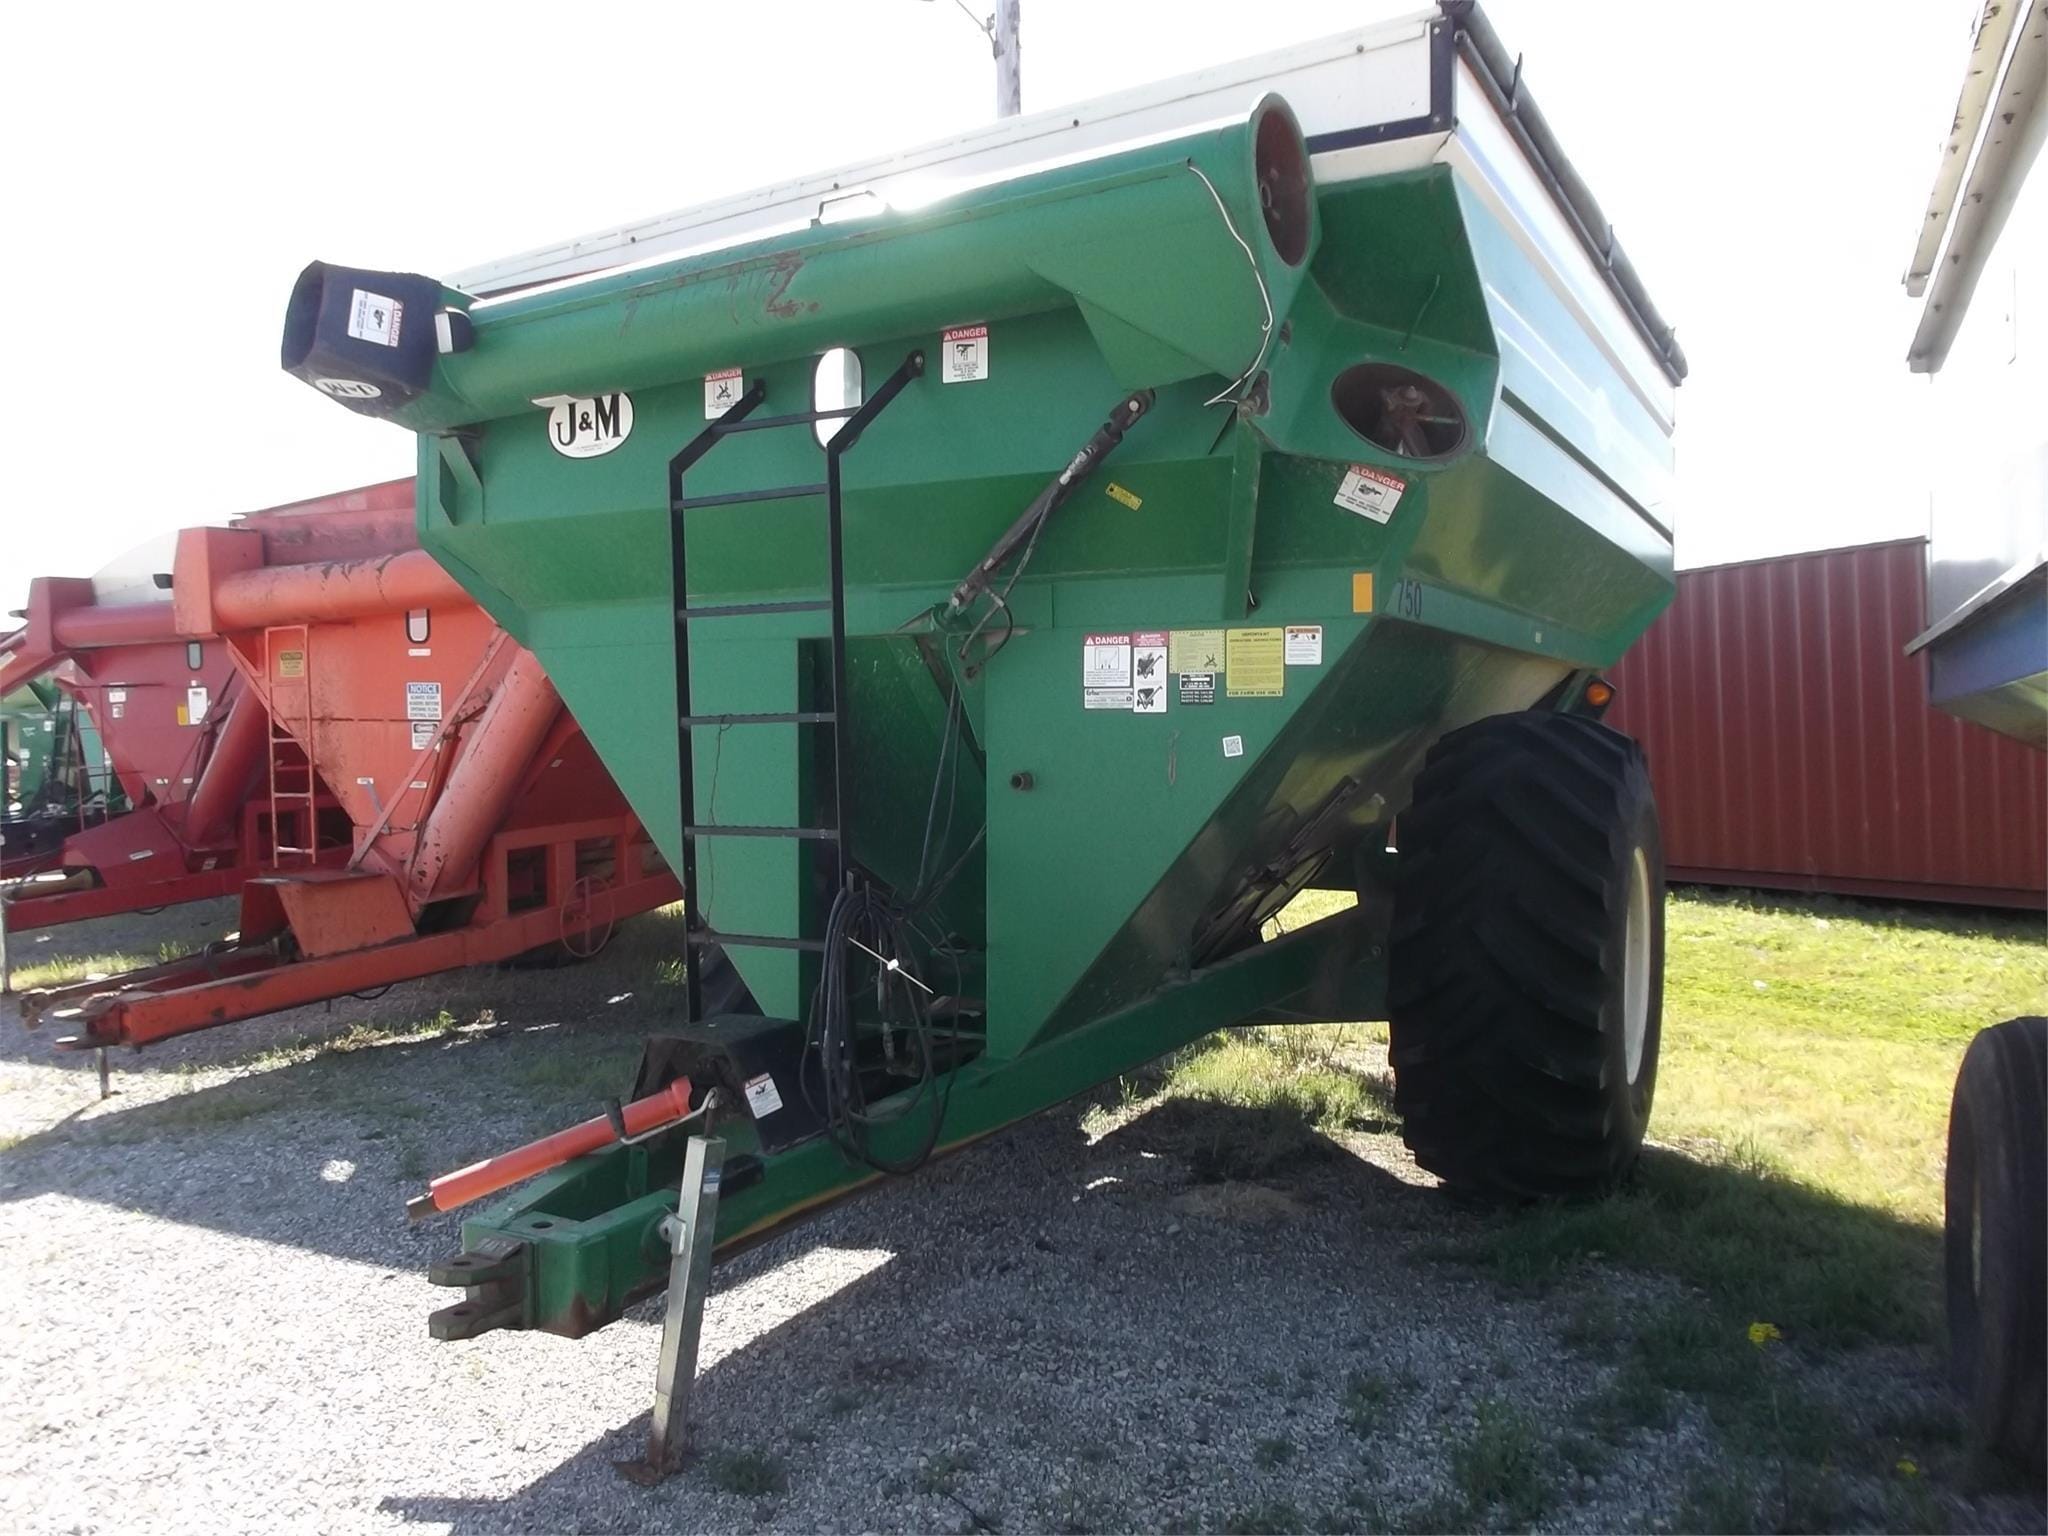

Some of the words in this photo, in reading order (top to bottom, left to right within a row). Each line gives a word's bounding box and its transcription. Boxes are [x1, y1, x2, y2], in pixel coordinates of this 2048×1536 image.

[389, 311, 402, 347] DANGER
[951, 327, 988, 340] DANGER
[711, 369, 742, 380] DANGER
[556, 394, 622, 446] J&M
[1361, 468, 1406, 491] DANGER
[1398, 580, 1422, 619] 750
[1095, 636, 1130, 644] DANGER
[410, 684, 437, 694] NOTICE
